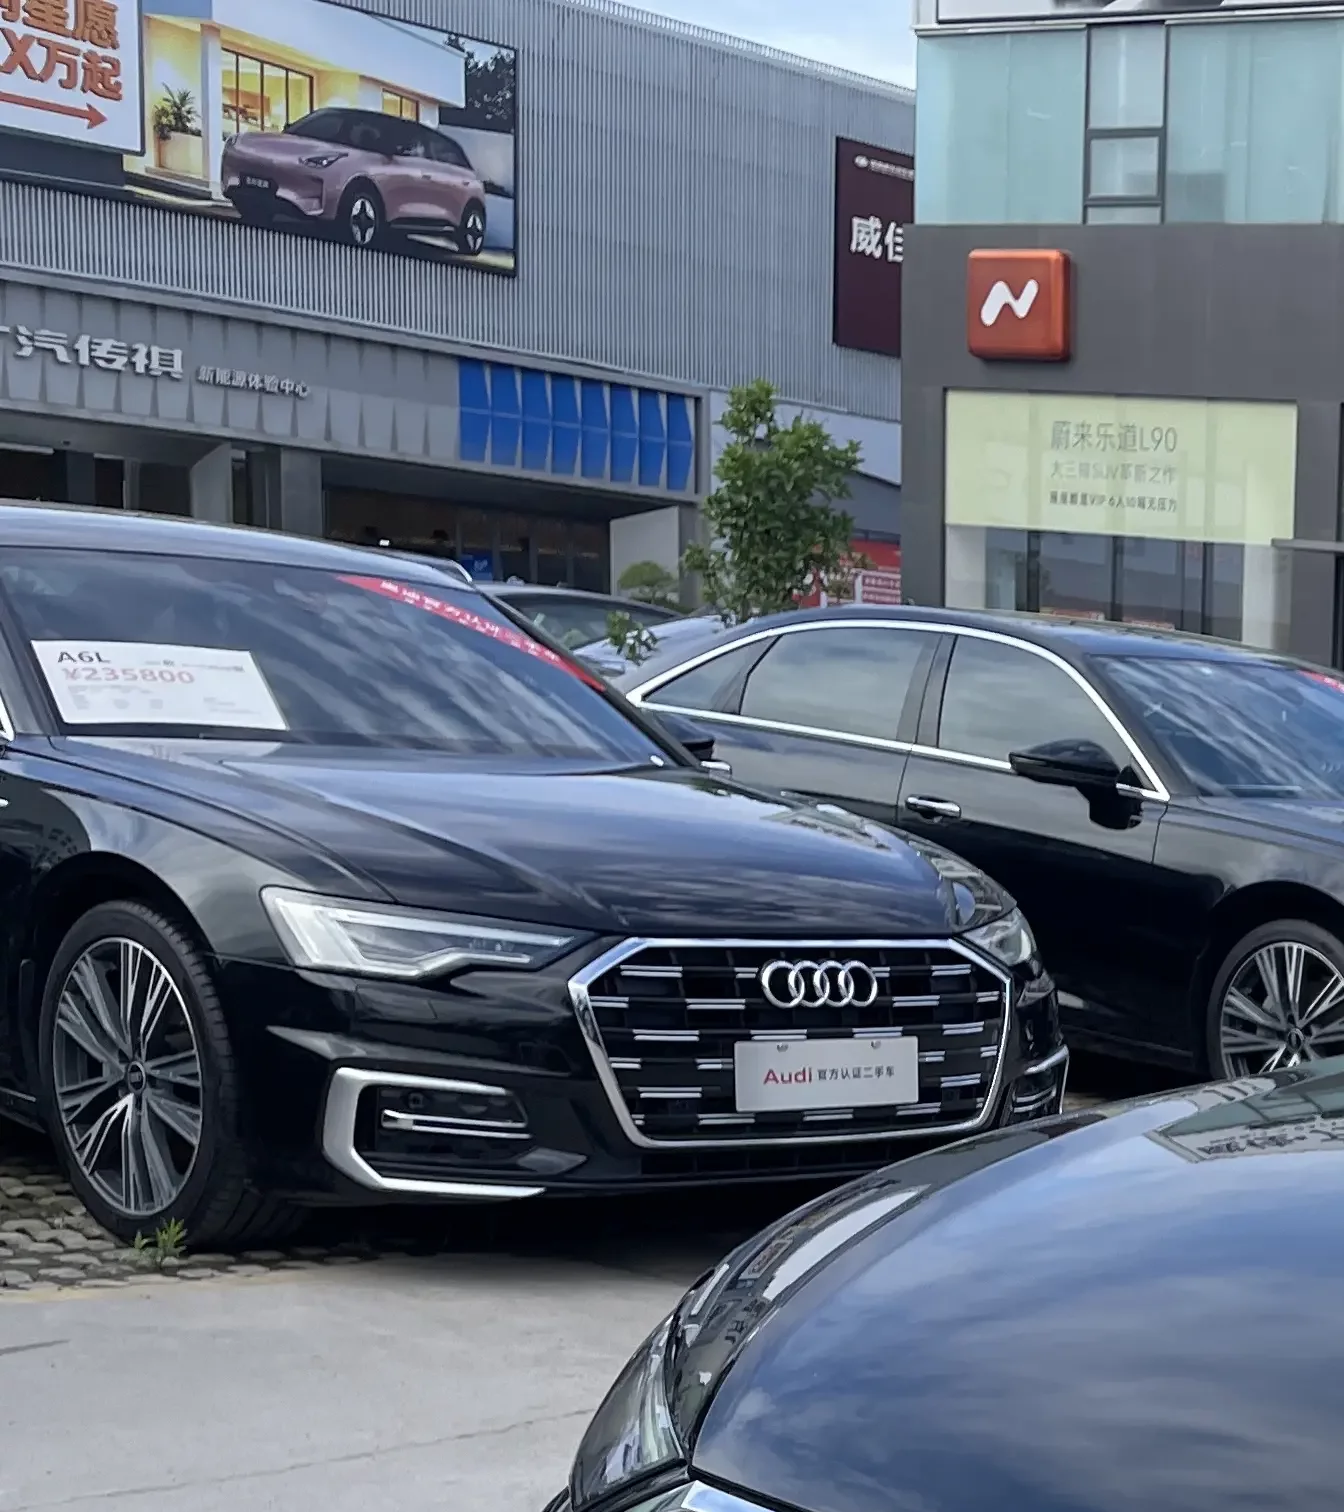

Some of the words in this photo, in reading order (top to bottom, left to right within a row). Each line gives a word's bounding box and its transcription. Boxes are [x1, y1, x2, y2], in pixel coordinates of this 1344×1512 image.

[0, 0, 119, 49] 星愿
[0, 325, 184, 379] 汽传祺
[198, 365, 311, 399] 新能源体验中心
[57, 651, 111, 663] A6L
[763, 1067, 813, 1085] Audi
[818, 1065, 895, 1081] 官方认证二手车
